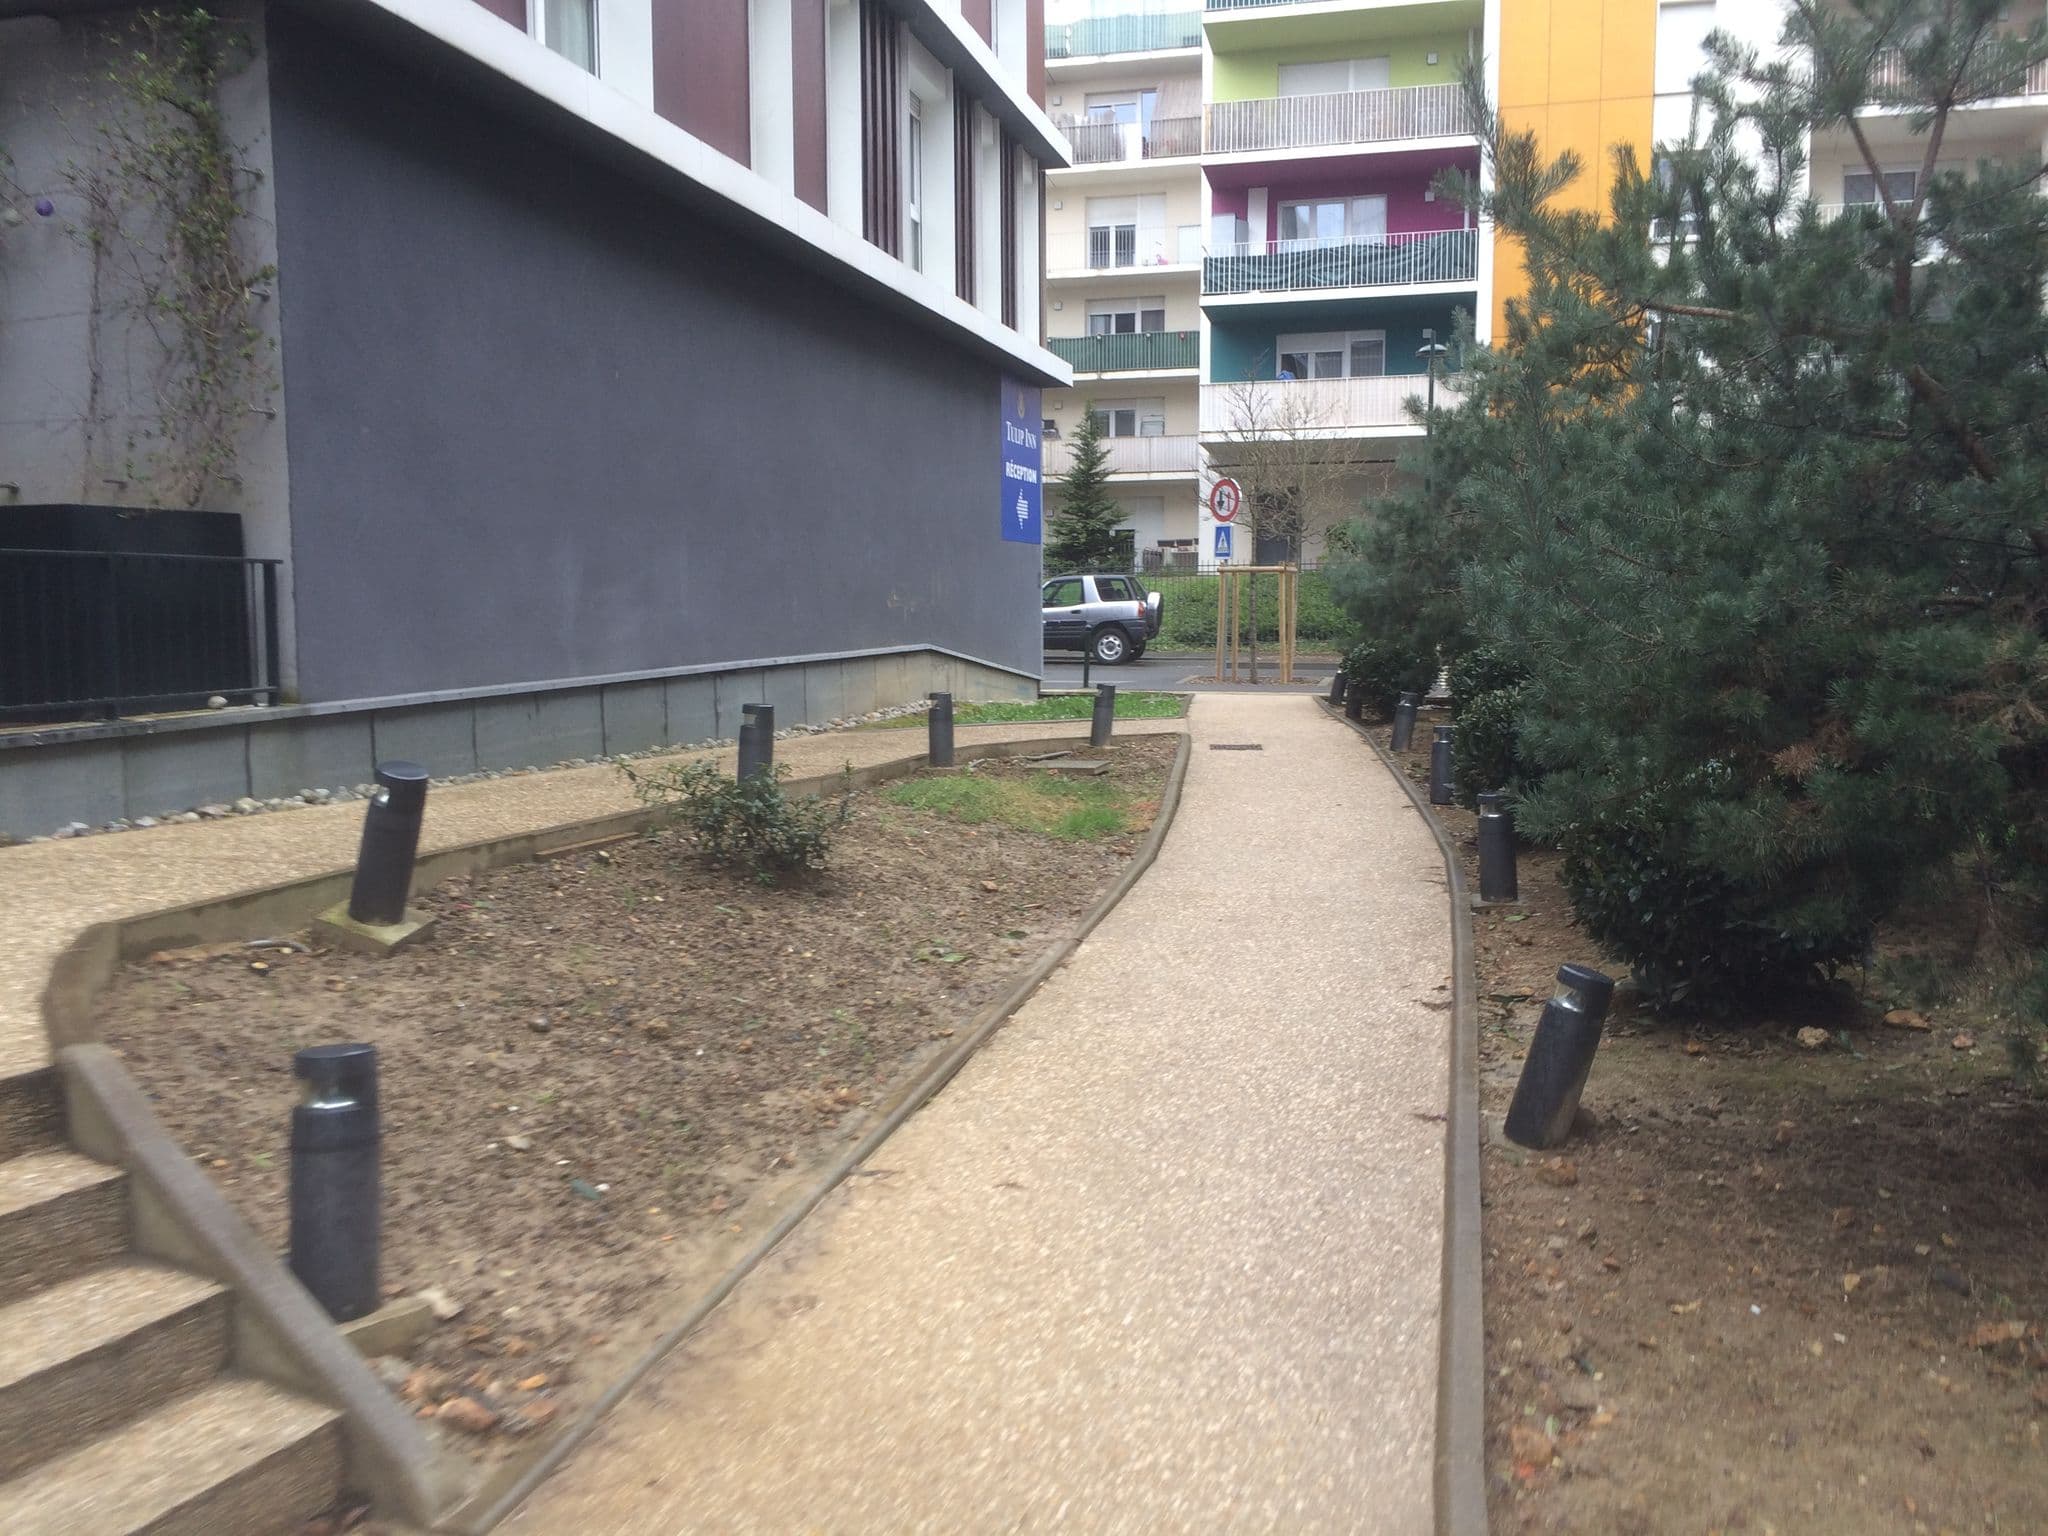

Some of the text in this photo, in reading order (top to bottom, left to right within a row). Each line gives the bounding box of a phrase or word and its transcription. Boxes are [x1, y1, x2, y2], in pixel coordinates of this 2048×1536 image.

[1005, 420, 1037, 449] TULIP INN
[1005, 459, 1037, 484] RÉCEPTION
